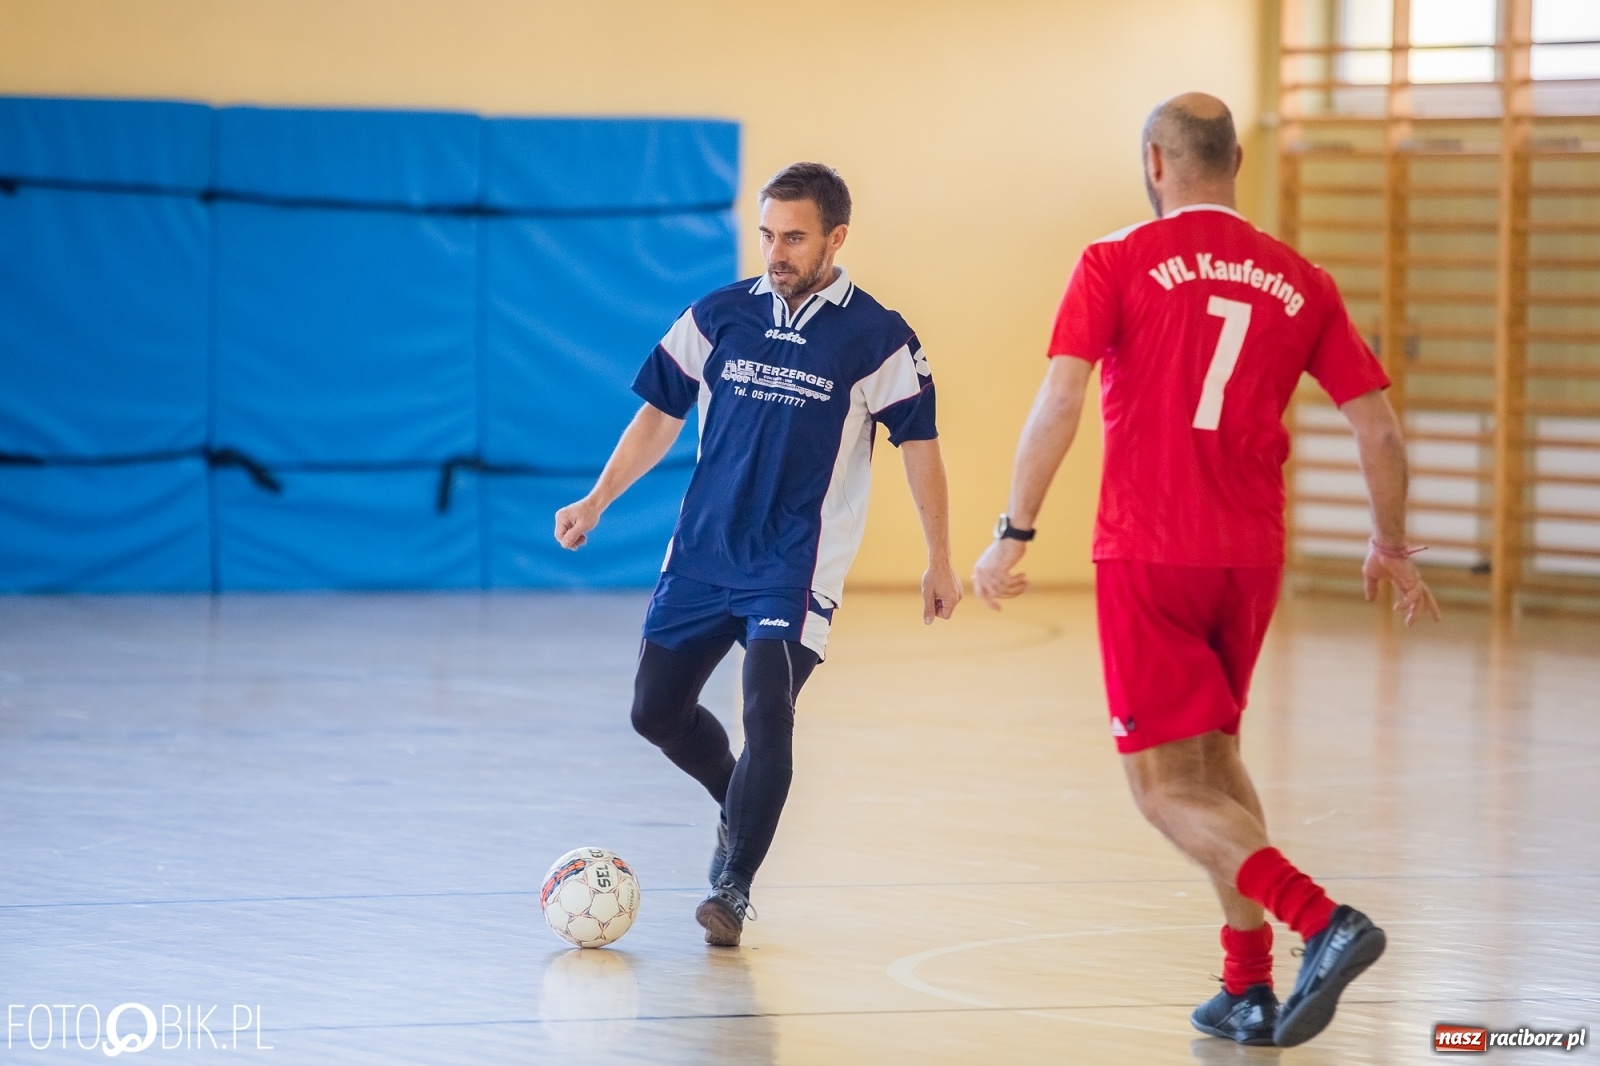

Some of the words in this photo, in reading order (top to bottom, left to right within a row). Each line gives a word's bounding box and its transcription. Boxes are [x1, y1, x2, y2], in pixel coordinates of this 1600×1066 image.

[1148, 255, 1196, 291] VfL
[1196, 252, 1305, 317] Kaufering
[734, 386, 748, 397] Tel.
[1192, 295, 1252, 431] 7
